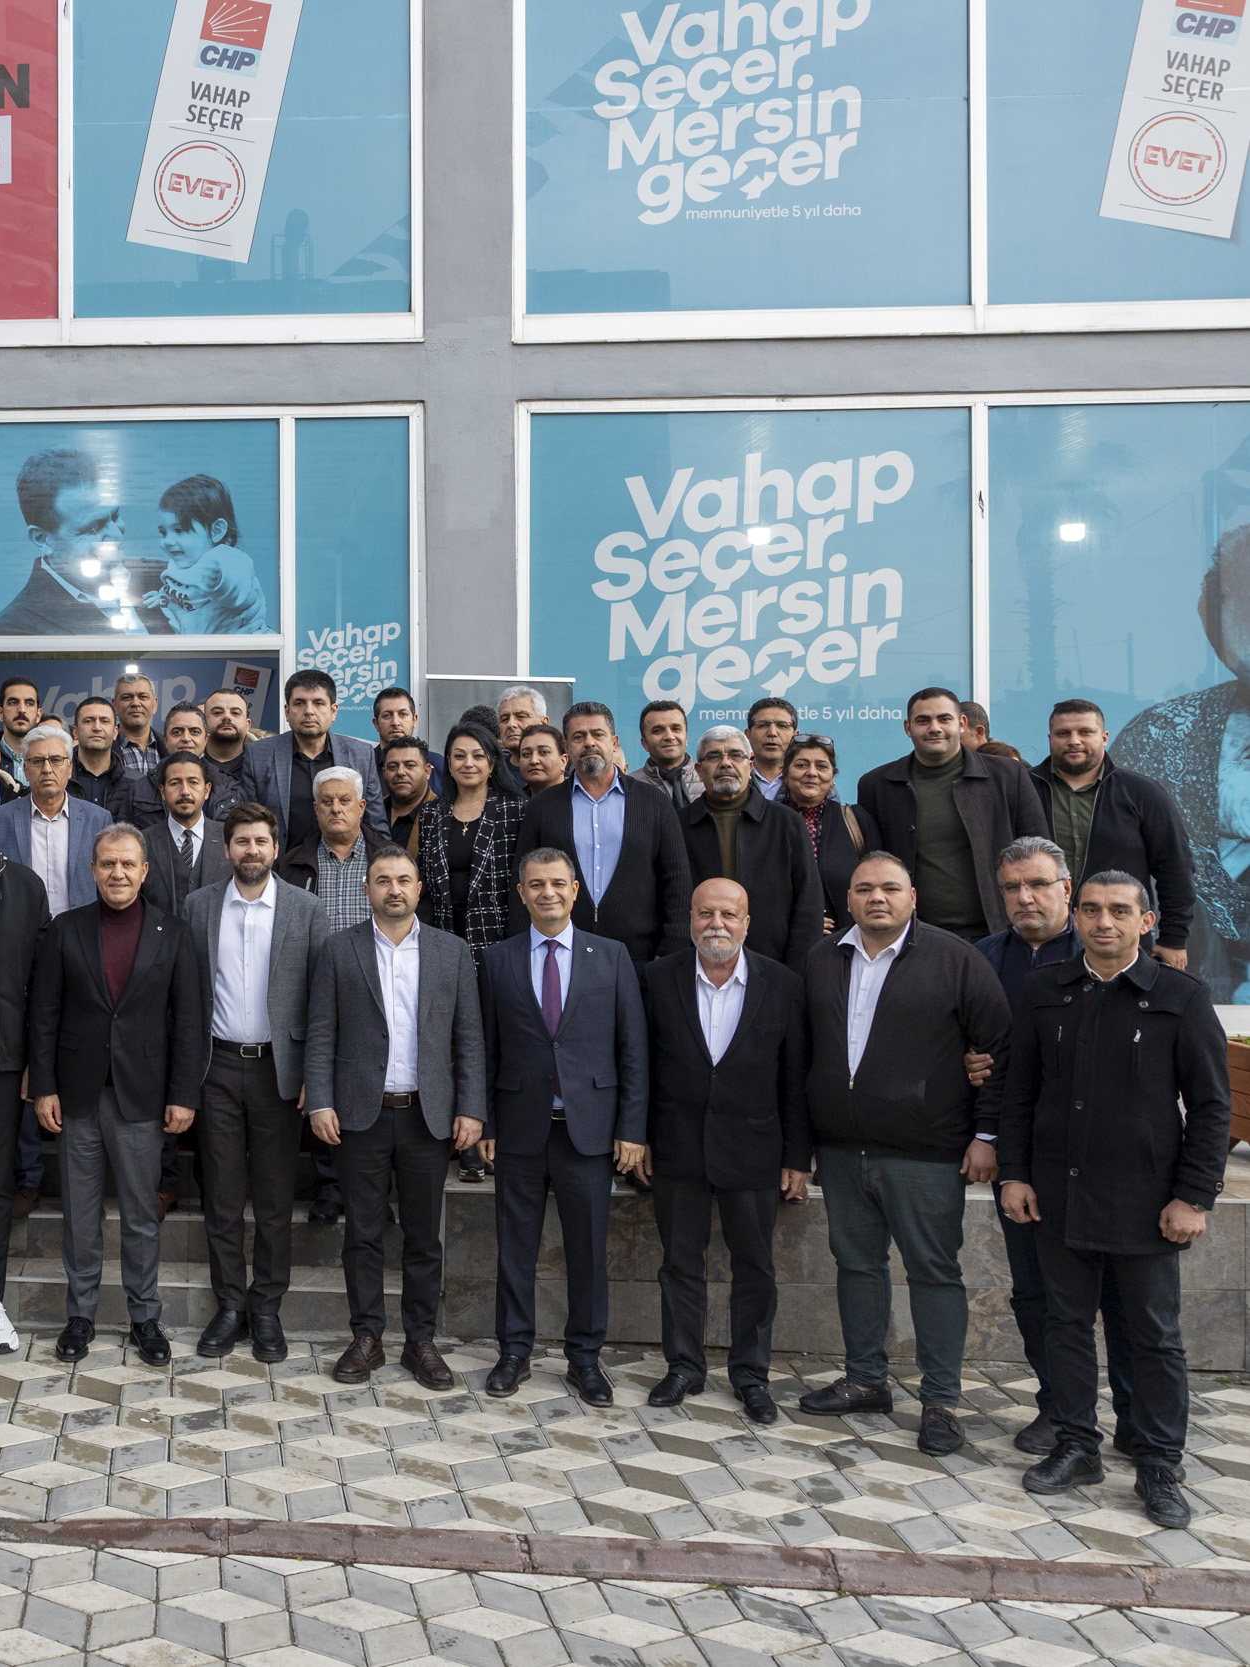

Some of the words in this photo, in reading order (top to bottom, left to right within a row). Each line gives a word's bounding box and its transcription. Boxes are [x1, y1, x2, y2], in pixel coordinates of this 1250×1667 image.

[620, 0, 872, 66] Vahap
[1176, 12, 1236, 39] CHP
[200, 45, 256, 71] CHP
[1167, 50, 1231, 78] VAHAP
[191, 81, 251, 109] VAHAP
[1161, 74, 1224, 103] SEÇER
[185, 104, 244, 132] SEÇER
[608, 74, 862, 170] Mersin
[1143, 145, 1212, 174] EVET
[168, 173, 232, 201] EVET
[637, 131, 858, 225] geçer
[686, 203, 789, 220] memnuniyetle
[792, 205, 801, 217] 5
[804, 203, 820, 219] yıl
[823, 203, 861, 217] daha
[624, 450, 915, 540] Vahap
[608, 553, 903, 662] Mersin
[307, 622, 401, 652] Vahap
[321, 655, 397, 687] ersin
[234, 686, 255, 696] CHP
[336, 677, 396, 704] eçer
[822, 707, 832, 719] 5
[836, 706, 854, 723] yıl
[857, 706, 902, 720] daha
